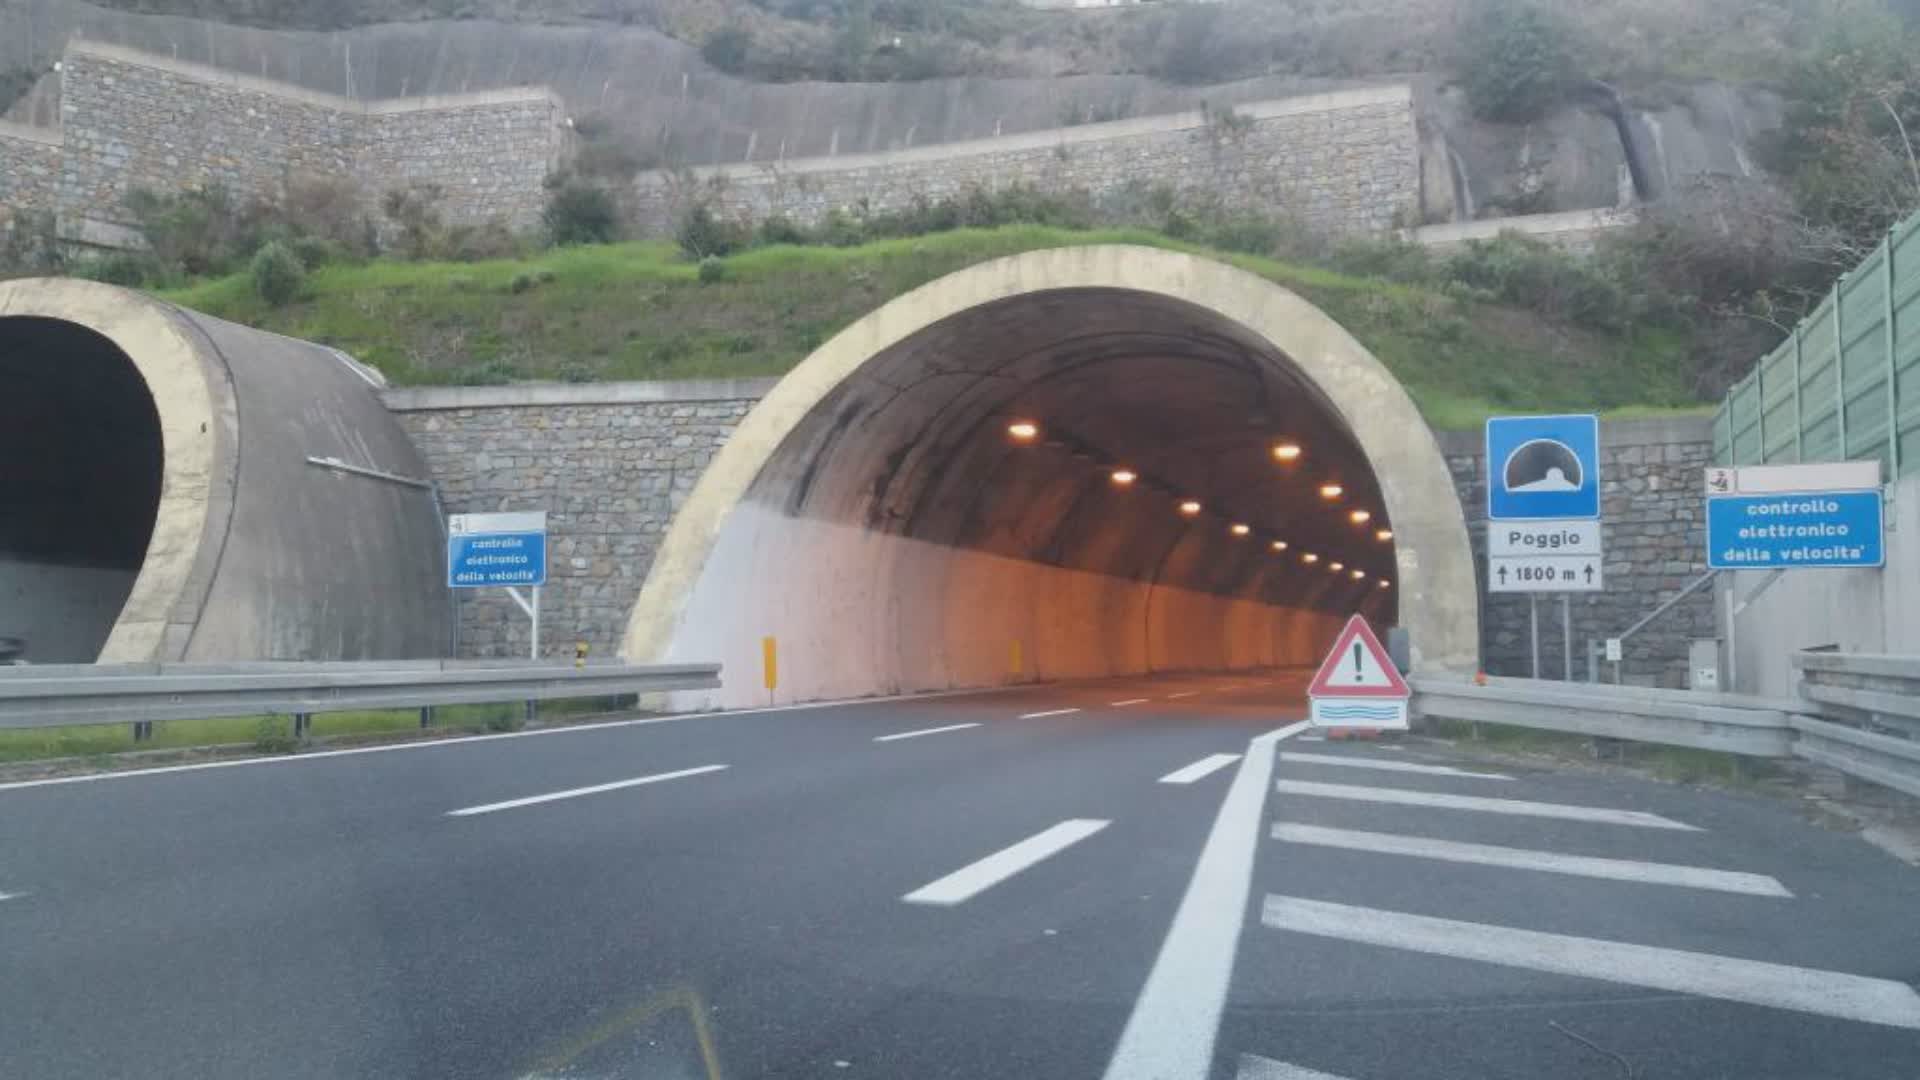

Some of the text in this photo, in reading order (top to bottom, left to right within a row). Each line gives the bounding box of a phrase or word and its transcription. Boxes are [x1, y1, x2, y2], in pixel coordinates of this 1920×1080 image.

[1747, 500, 1839, 516] controllo
[1739, 523, 1849, 539] elettronico
[471, 538, 523, 549] controllo
[1508, 531, 1581, 548] Poggio
[466, 554, 528, 565] elettronico
[1723, 547, 1771, 562] della
[456, 571, 484, 582] della
[1516, 566, 1576, 581] 1800 m
